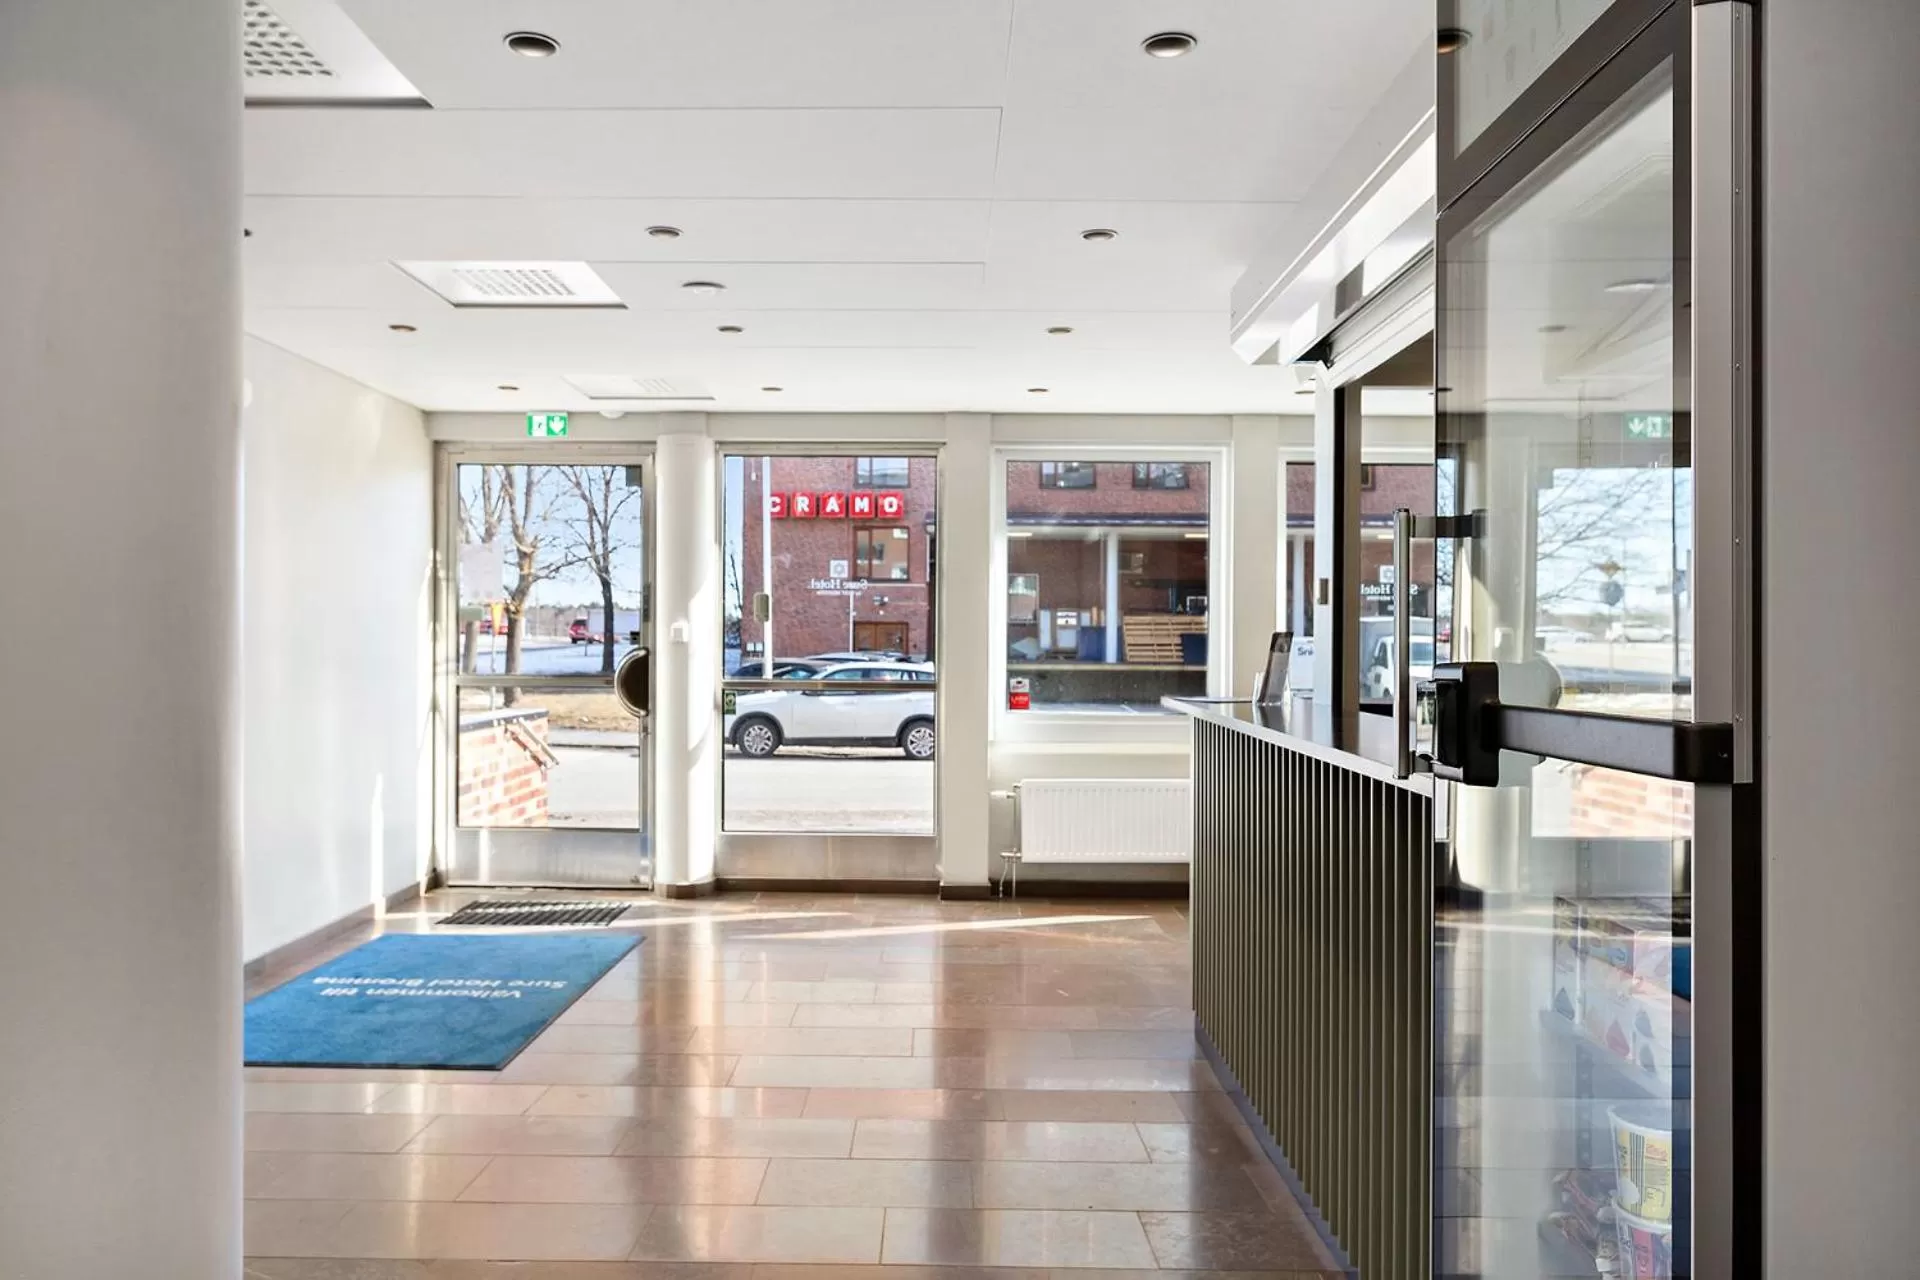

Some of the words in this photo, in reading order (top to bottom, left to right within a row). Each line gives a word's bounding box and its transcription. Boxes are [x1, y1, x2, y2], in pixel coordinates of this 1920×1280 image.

[769, 496, 898, 513] CRAMO
[312, 977, 425, 987] Bromma
[427, 979, 502, 988] Hotel
[508, 979, 568, 988] Sure
[320, 987, 358, 996] till
[366, 988, 521, 998] Välkommen
